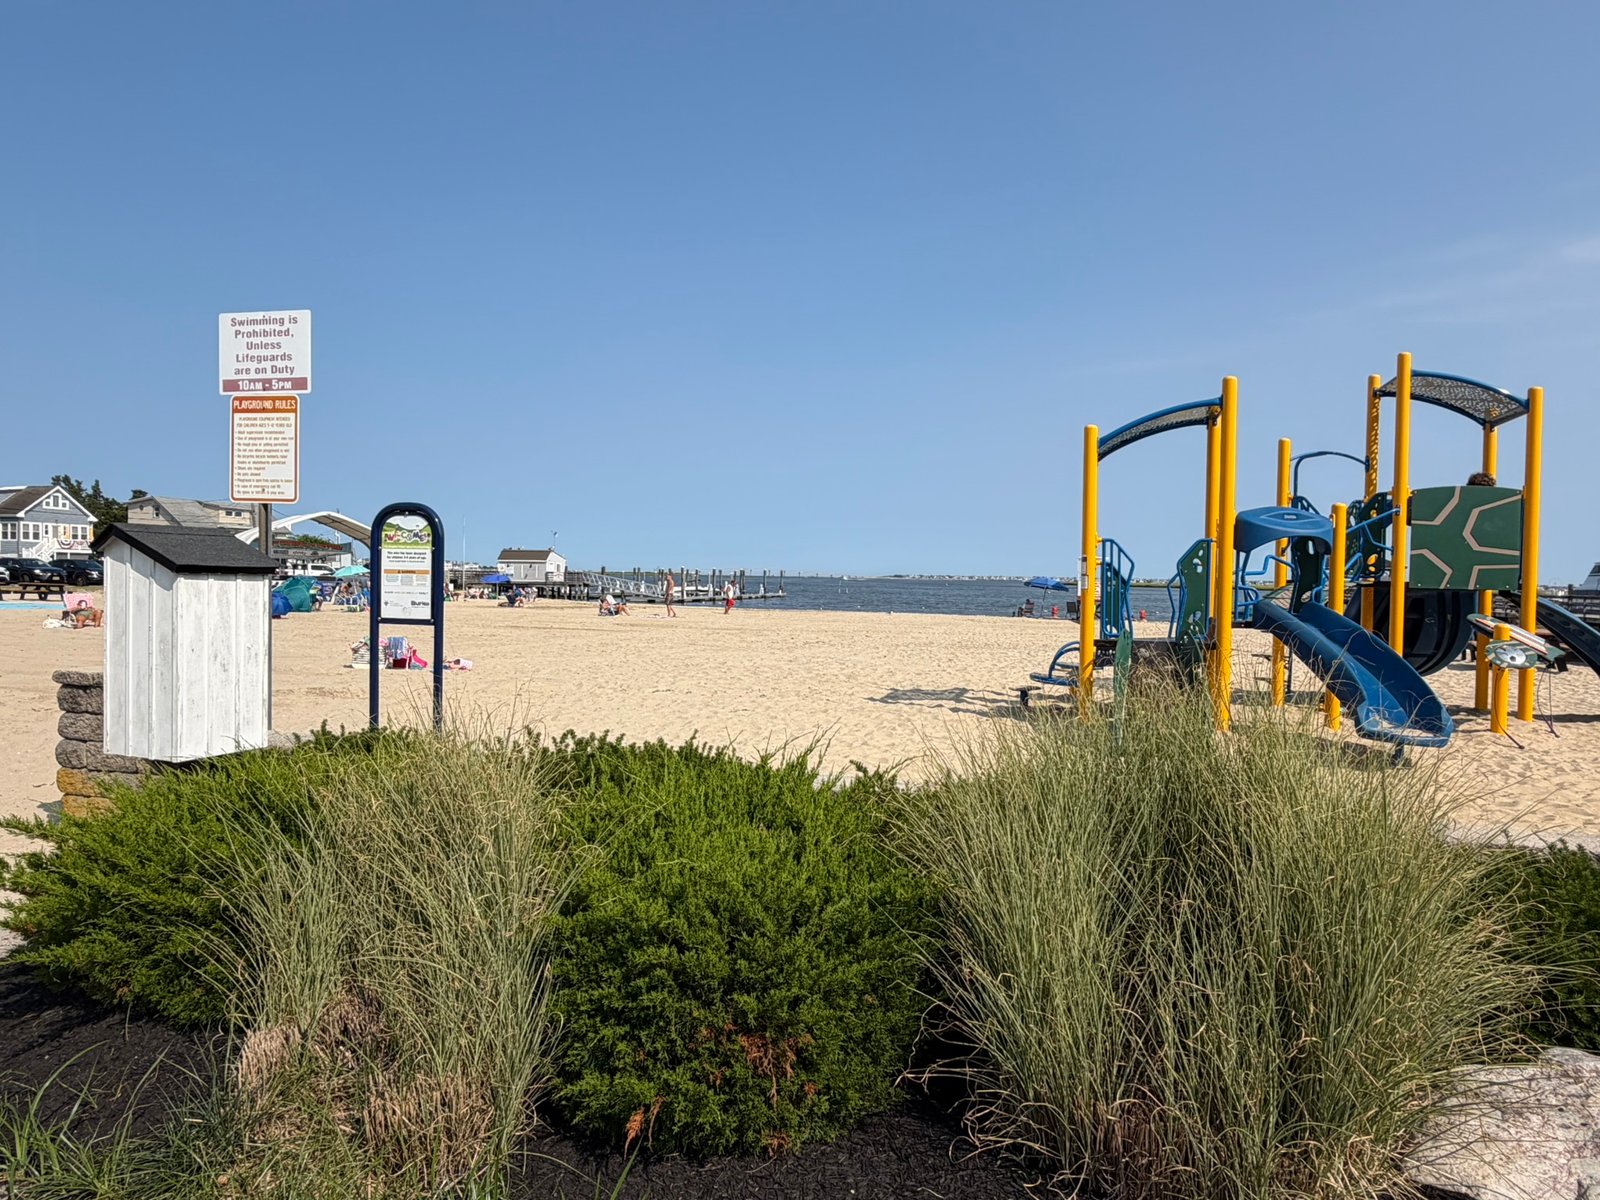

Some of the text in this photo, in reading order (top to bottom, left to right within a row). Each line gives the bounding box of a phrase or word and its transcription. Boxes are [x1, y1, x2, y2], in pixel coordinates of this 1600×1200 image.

[230, 315, 298, 327] Swimming is
[234, 327, 294, 339] Prohibited,
[246, 341, 282, 350] Unless
[236, 352, 293, 364] Lifeguards
[234, 365, 295, 376] are on Duty
[237, 380, 263, 391] 10AM
[272, 380, 292, 390] 5PM
[233, 400, 296, 409] PLAYGROUND RULES
